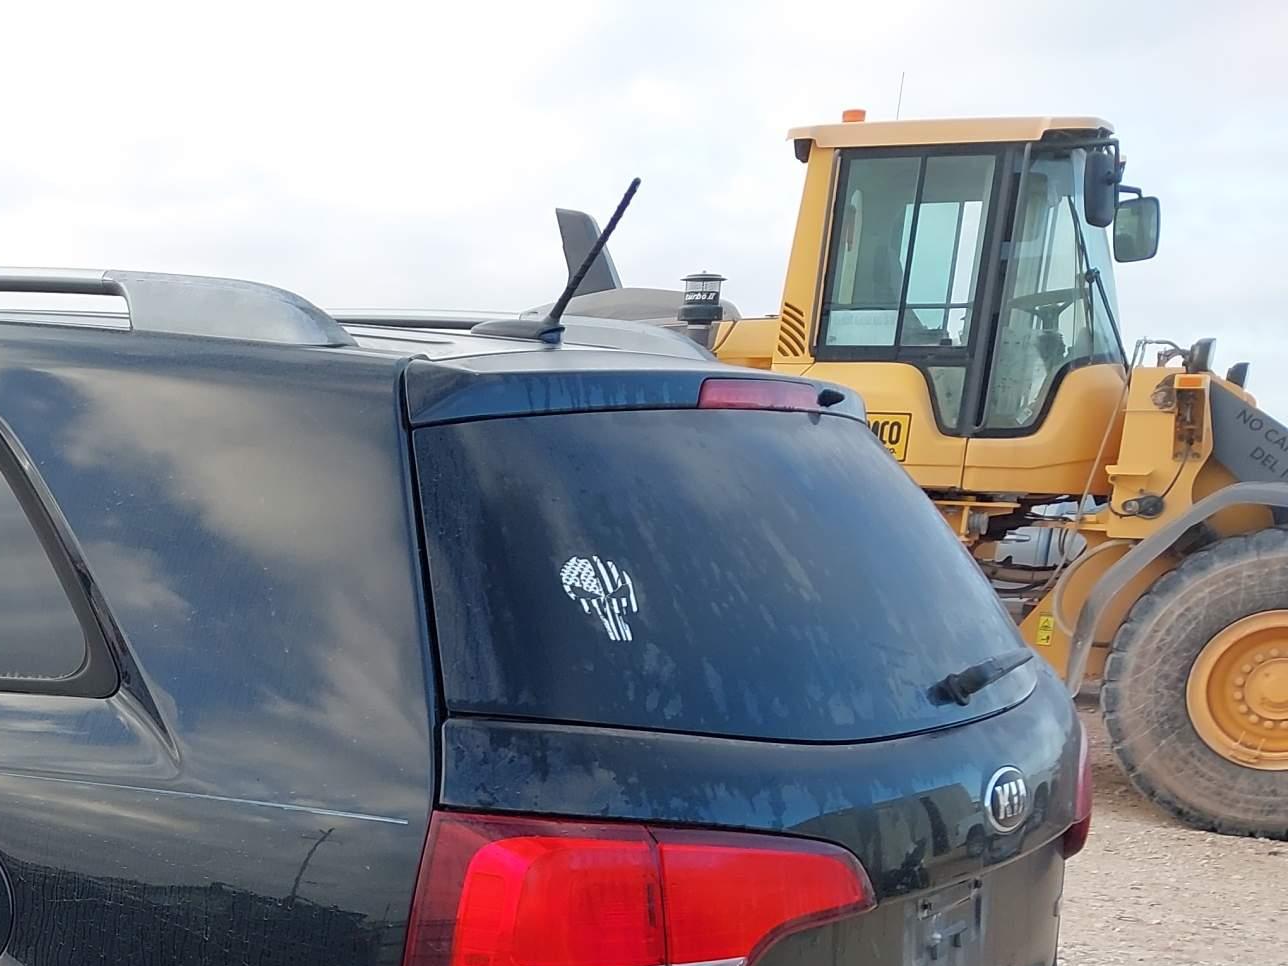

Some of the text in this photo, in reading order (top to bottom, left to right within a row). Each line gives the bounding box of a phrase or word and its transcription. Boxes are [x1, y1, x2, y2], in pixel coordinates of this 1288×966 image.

[1236, 409, 1264, 432] NO
[1249, 446, 1279, 473] DEL
[993, 777, 1028, 820] KIA
